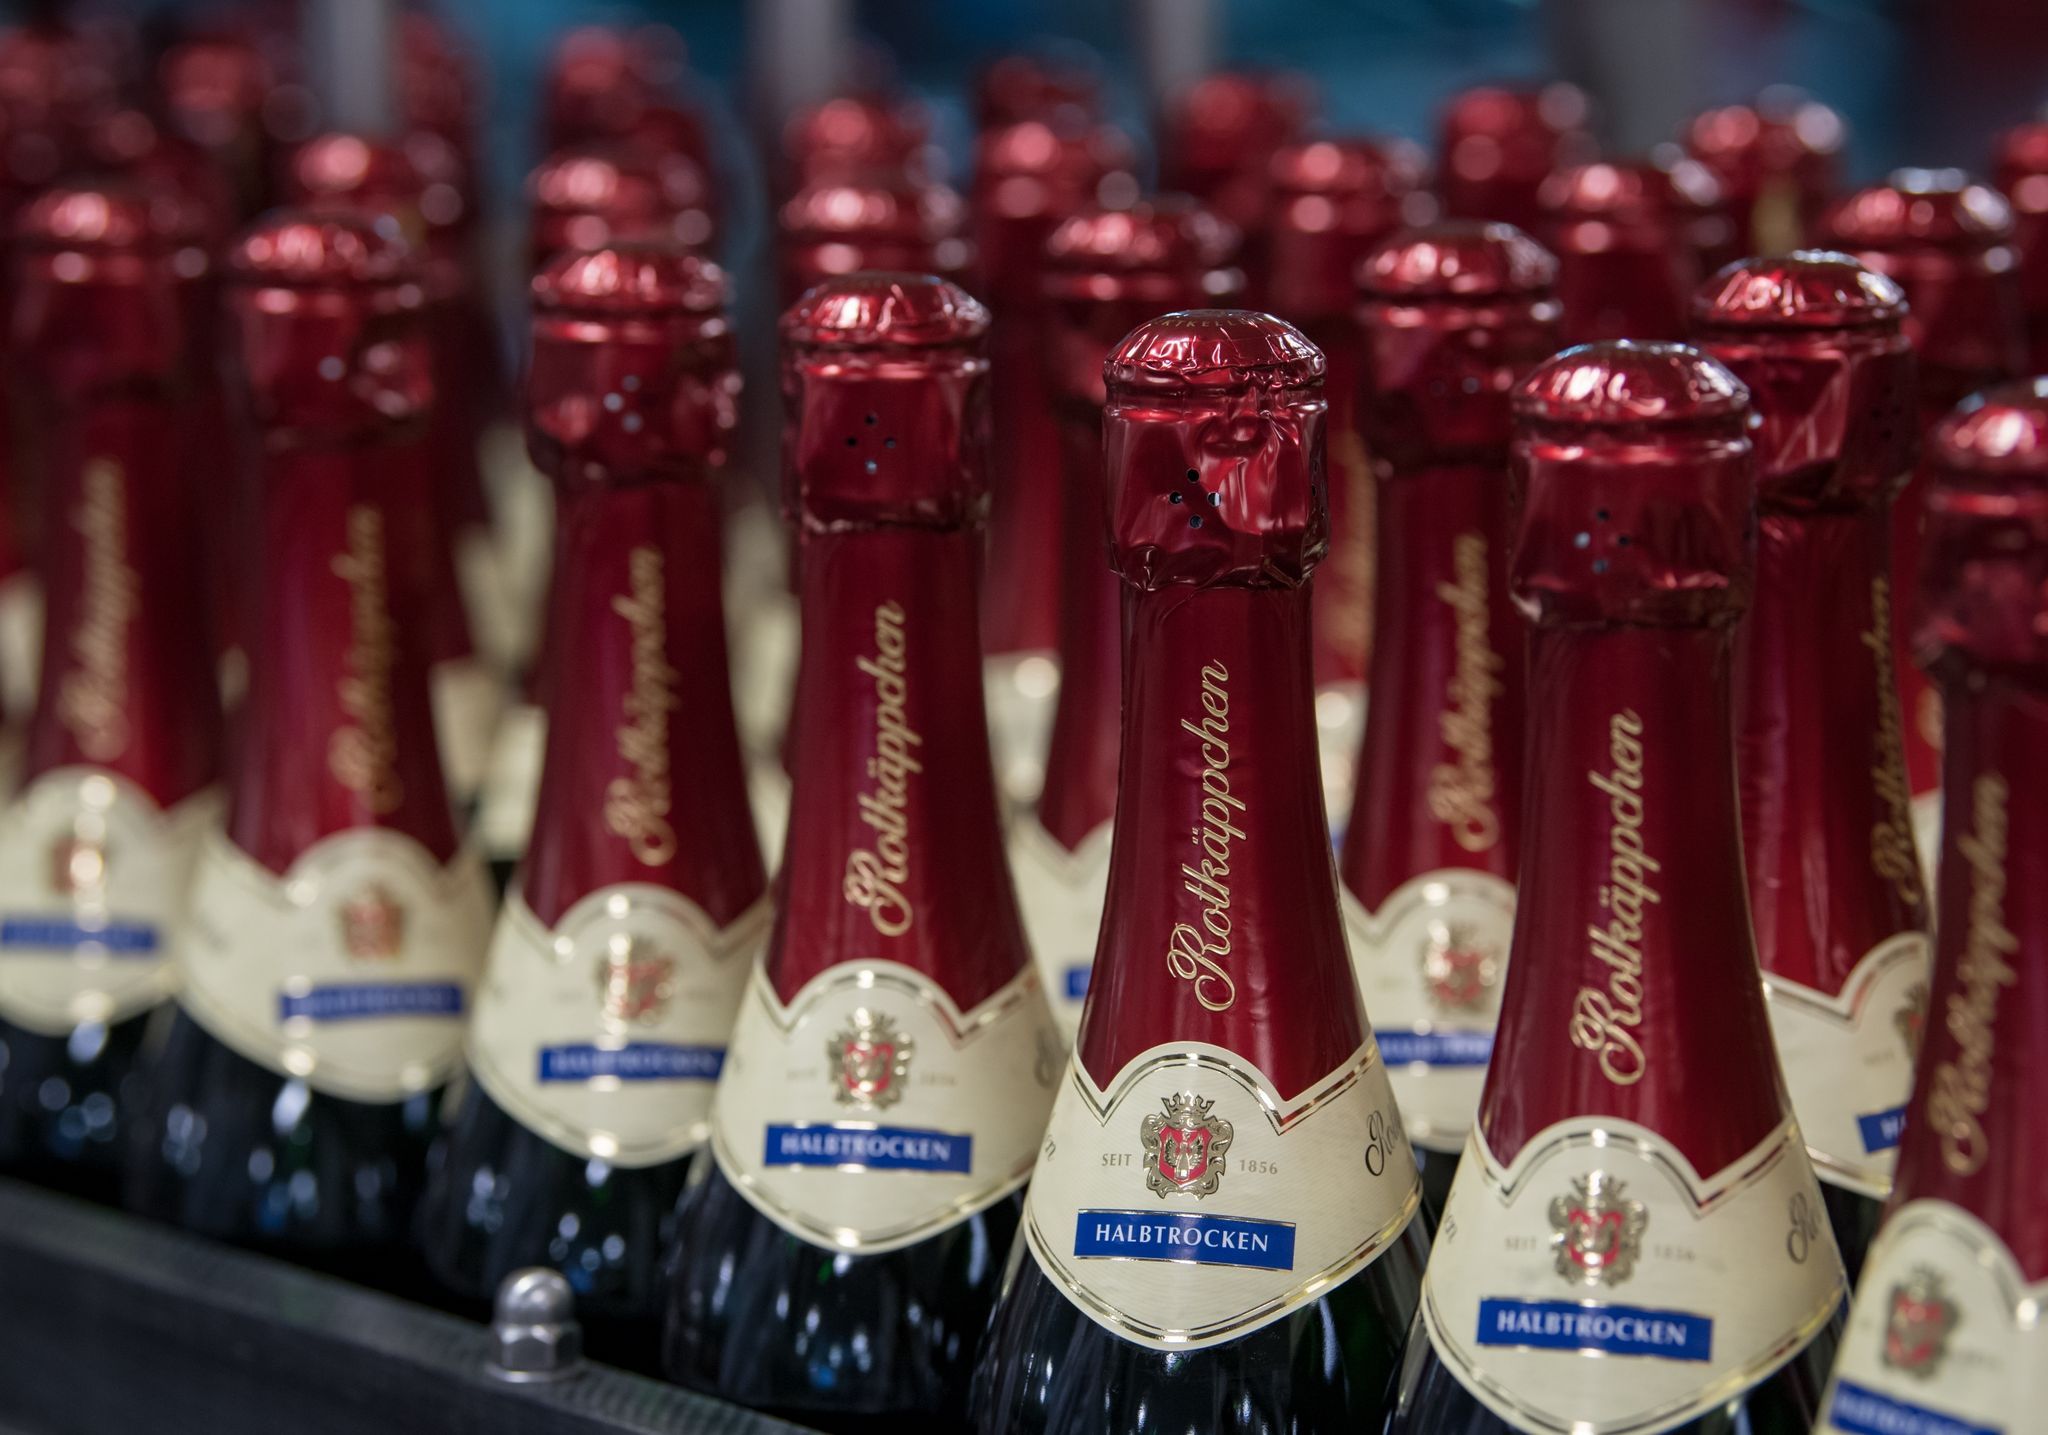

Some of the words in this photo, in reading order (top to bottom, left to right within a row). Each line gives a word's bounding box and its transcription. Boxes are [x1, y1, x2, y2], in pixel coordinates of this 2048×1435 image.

[843, 600, 923, 936] Rotkäppchen
[1167, 659, 1246, 1012] Rotkäppchen
[1569, 708, 1661, 1085] Rotkäppchen
[780, 1132, 951, 1161] HALBTROCKEN
[1101, 1153, 1132, 1167] SEIT
[1240, 1159, 1278, 1175] 1856
[1095, 1224, 1269, 1252] HALBTROCKEN
[1497, 1309, 1687, 1347] HALBTROCKEN
